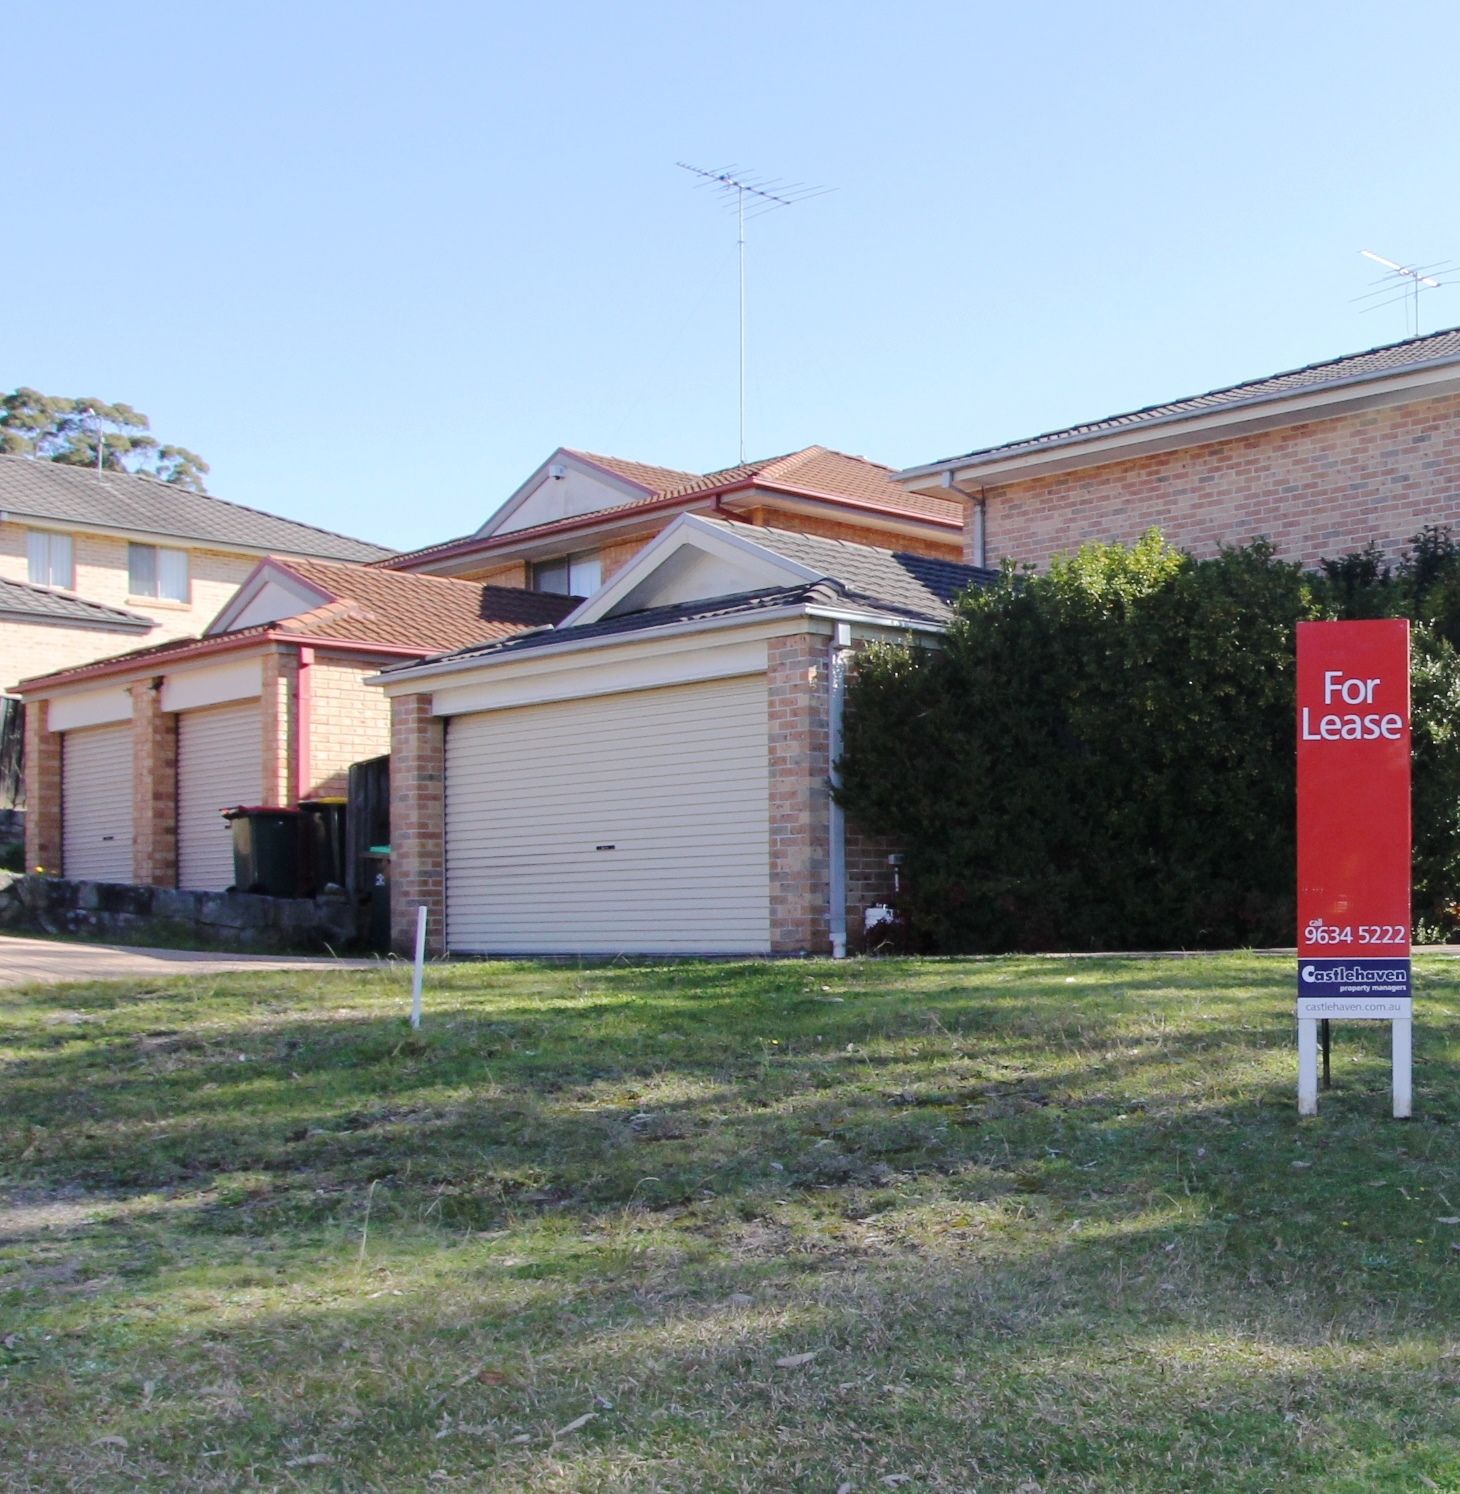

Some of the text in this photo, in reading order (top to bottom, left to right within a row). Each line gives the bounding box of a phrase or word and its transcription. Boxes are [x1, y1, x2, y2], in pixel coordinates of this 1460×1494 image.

[1324, 671, 1380, 705] For
[1302, 707, 1403, 741] Lease
[1309, 918, 1323, 926] call
[1304, 925, 1406, 944] 9634 5222
[1301, 965, 1407, 983] Castlehaven
[1339, 984, 1407, 993] property managers
